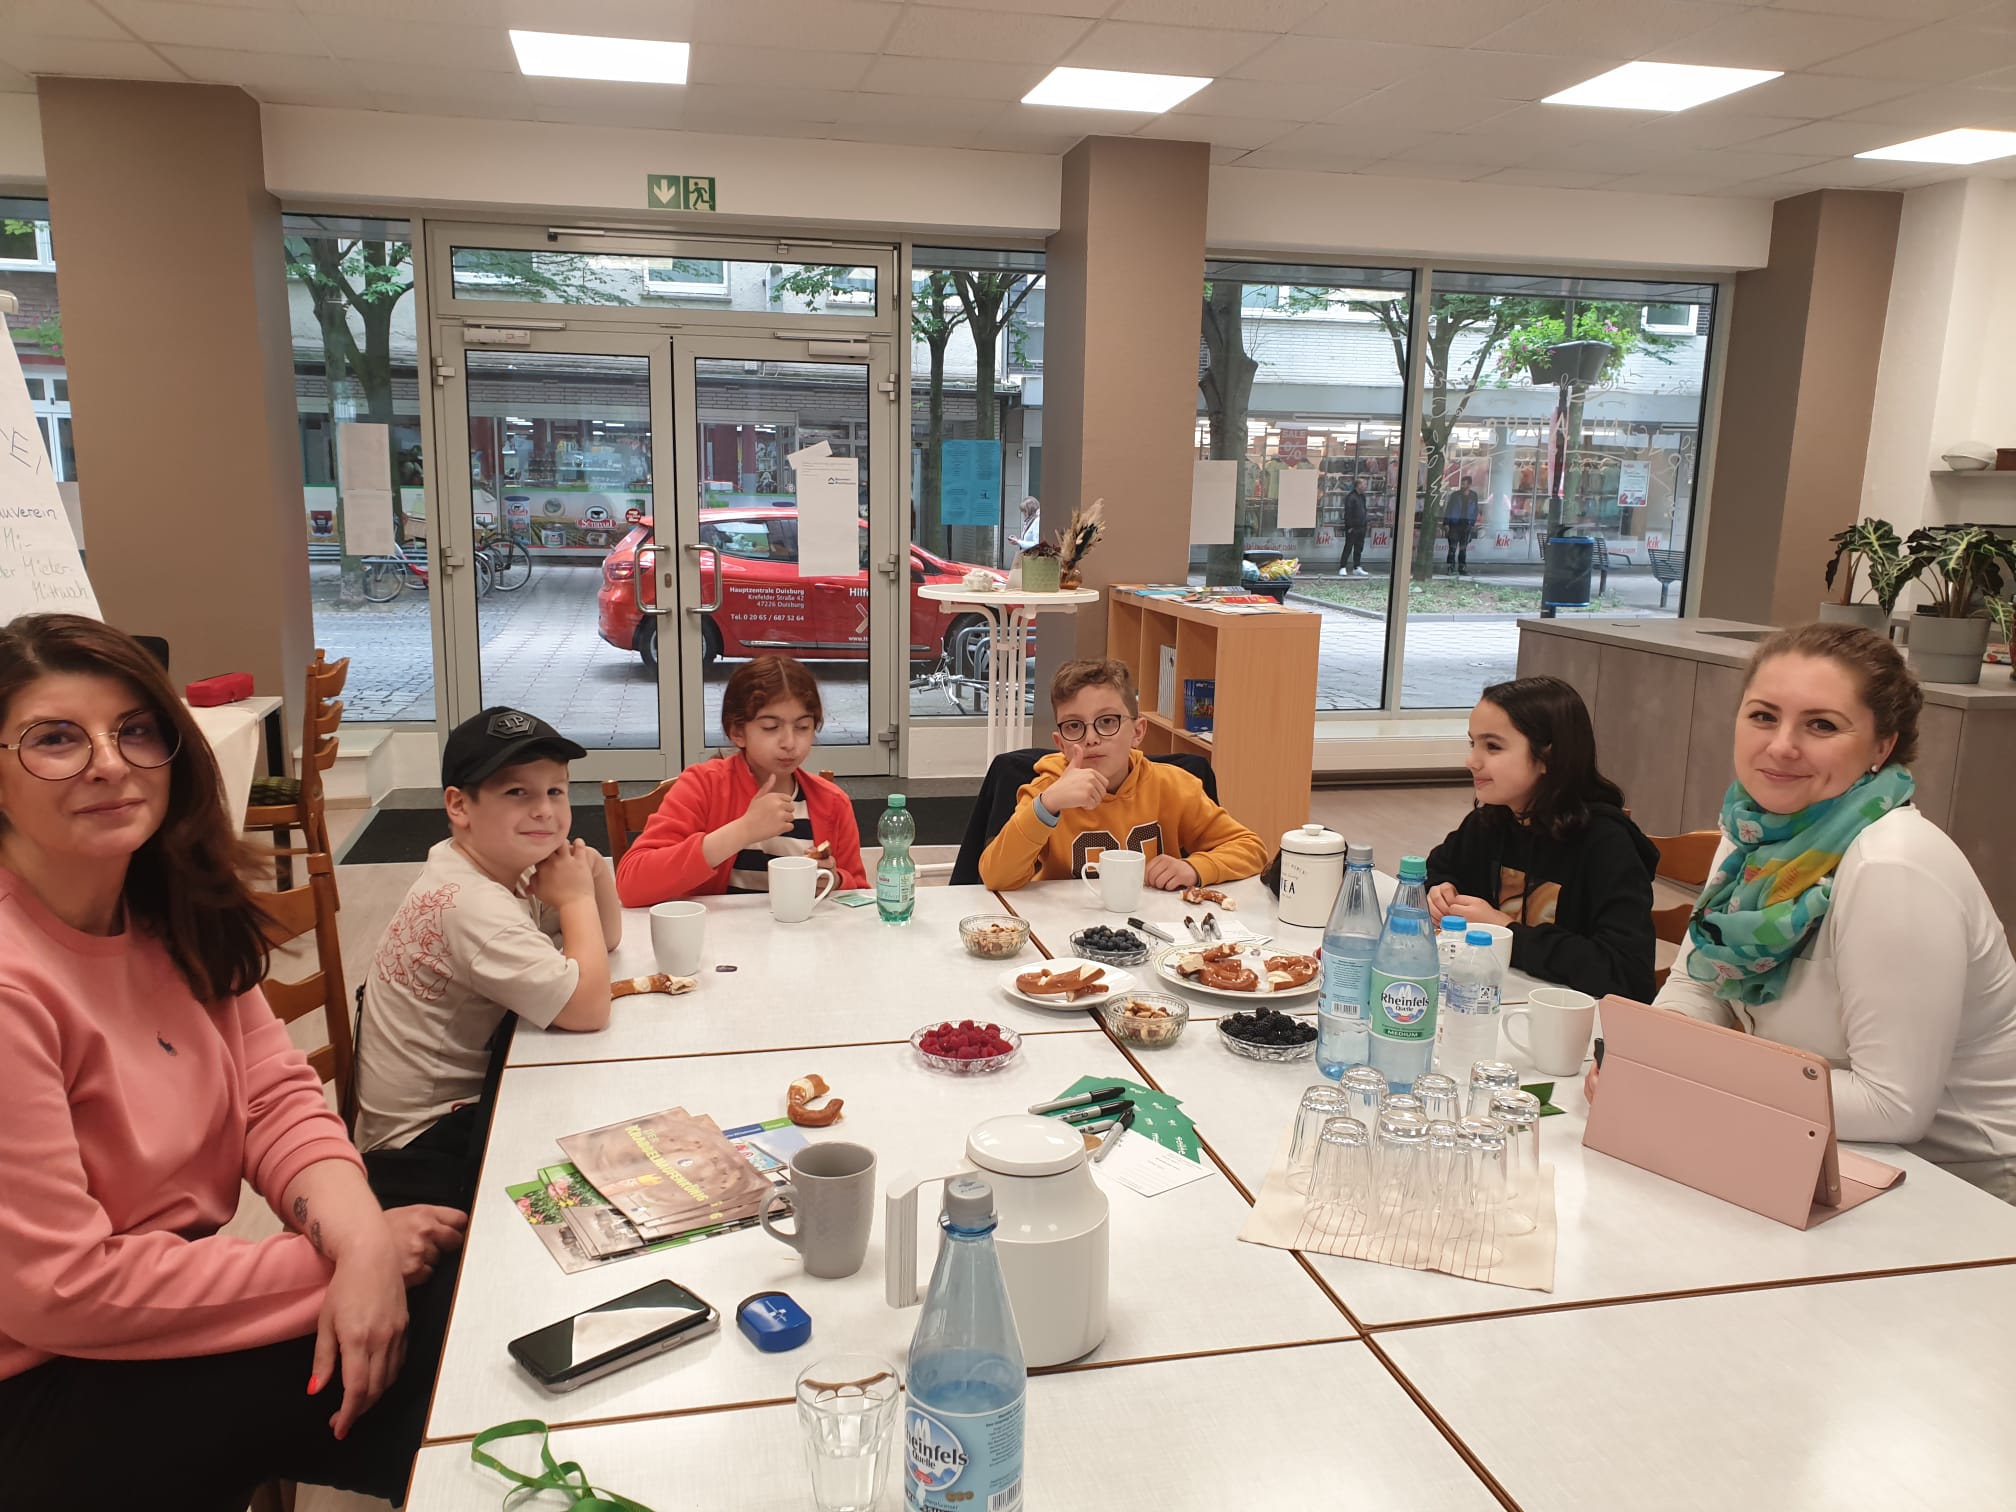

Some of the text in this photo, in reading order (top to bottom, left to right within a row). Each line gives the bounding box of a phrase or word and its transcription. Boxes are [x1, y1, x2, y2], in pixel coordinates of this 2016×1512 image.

[1282, 430, 1306, 439] SALE
[1315, 533, 1331, 545] kik
[1372, 533, 1387, 546] kik
[1496, 534, 1511, 547] kik
[1647, 536, 1660, 550] kik
[729, 586, 805, 596] Hauptzentrale Duisburg
[777, 601, 805, 609] Duisburg
[1380, 991, 1430, 1008] Rheinfels
[1387, 1029, 1419, 1038] MEDIUM
[906, 1423, 969, 1467] heinfels
